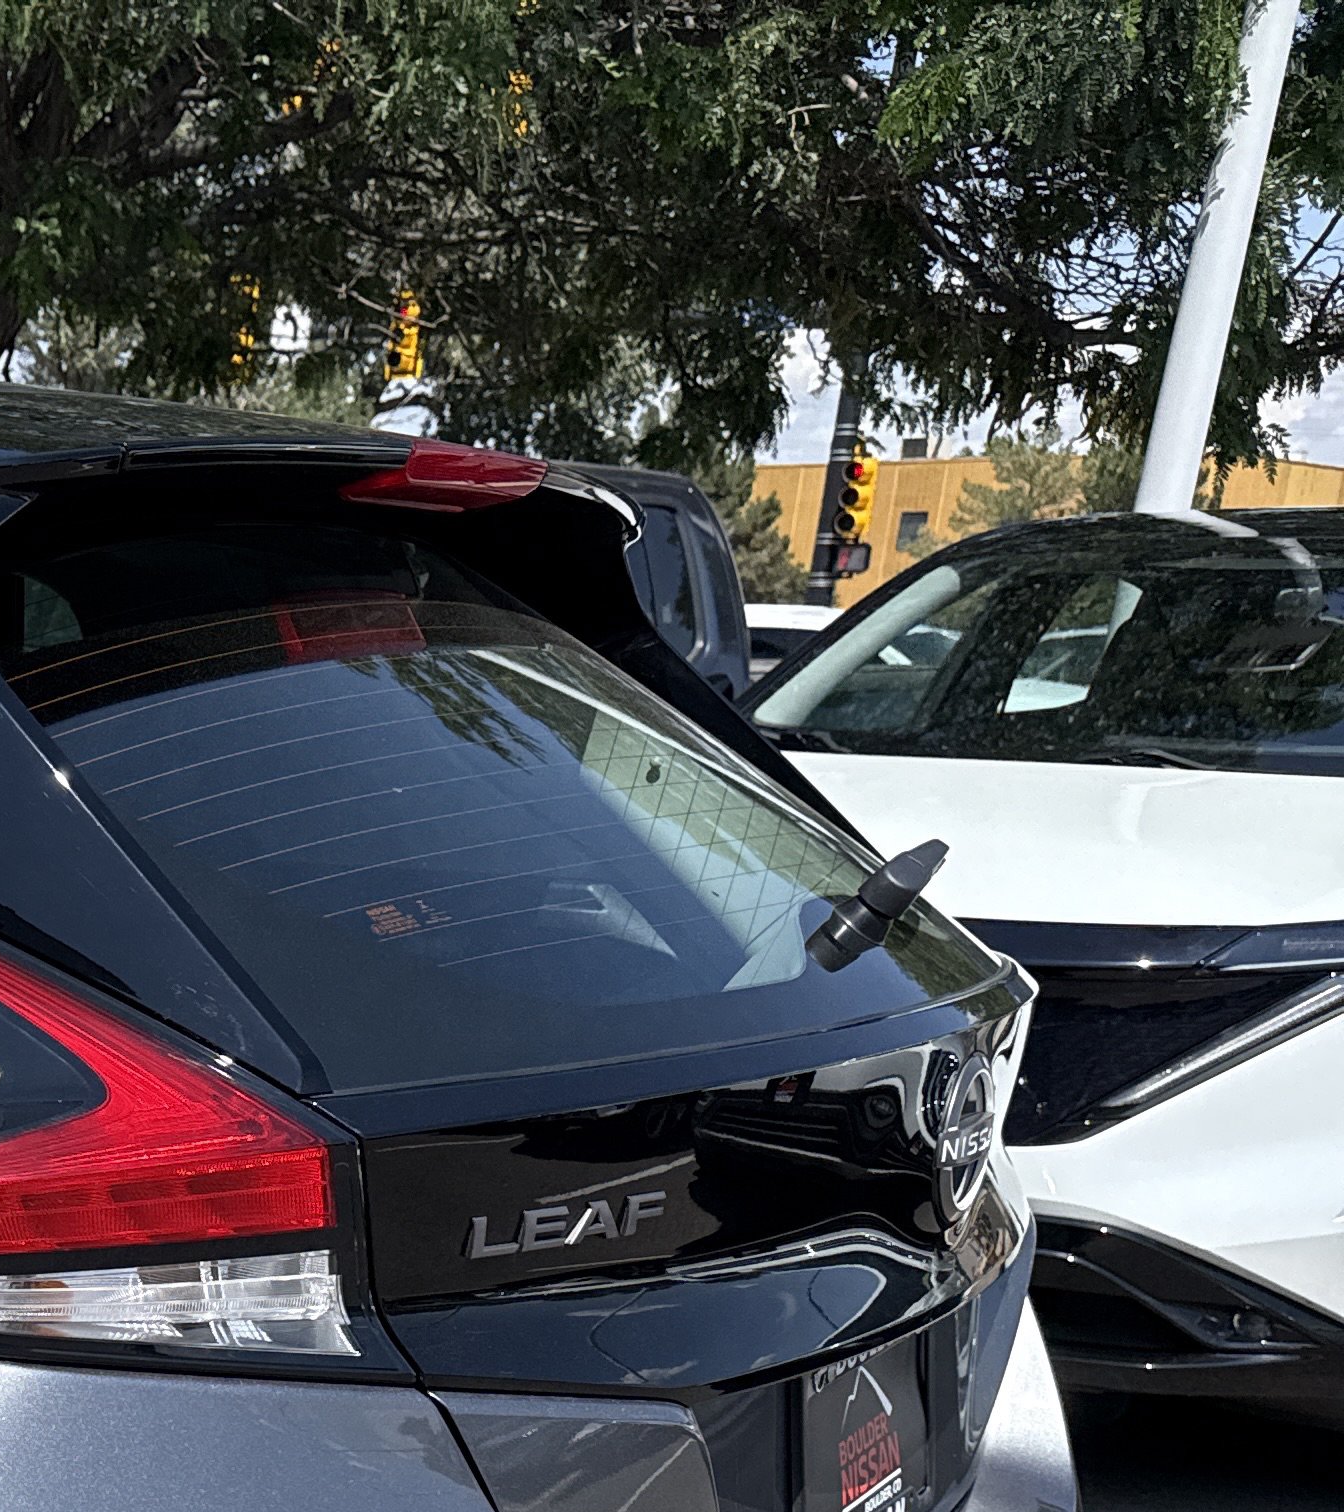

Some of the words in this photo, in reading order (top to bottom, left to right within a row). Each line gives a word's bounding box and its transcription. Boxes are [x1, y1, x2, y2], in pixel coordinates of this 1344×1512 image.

[940, 1126, 993, 1163] NISS
[462, 1189, 667, 1261] LEAF
[838, 1411, 889, 1467] BOULDER
[840, 1431, 902, 1507] NISSAN
